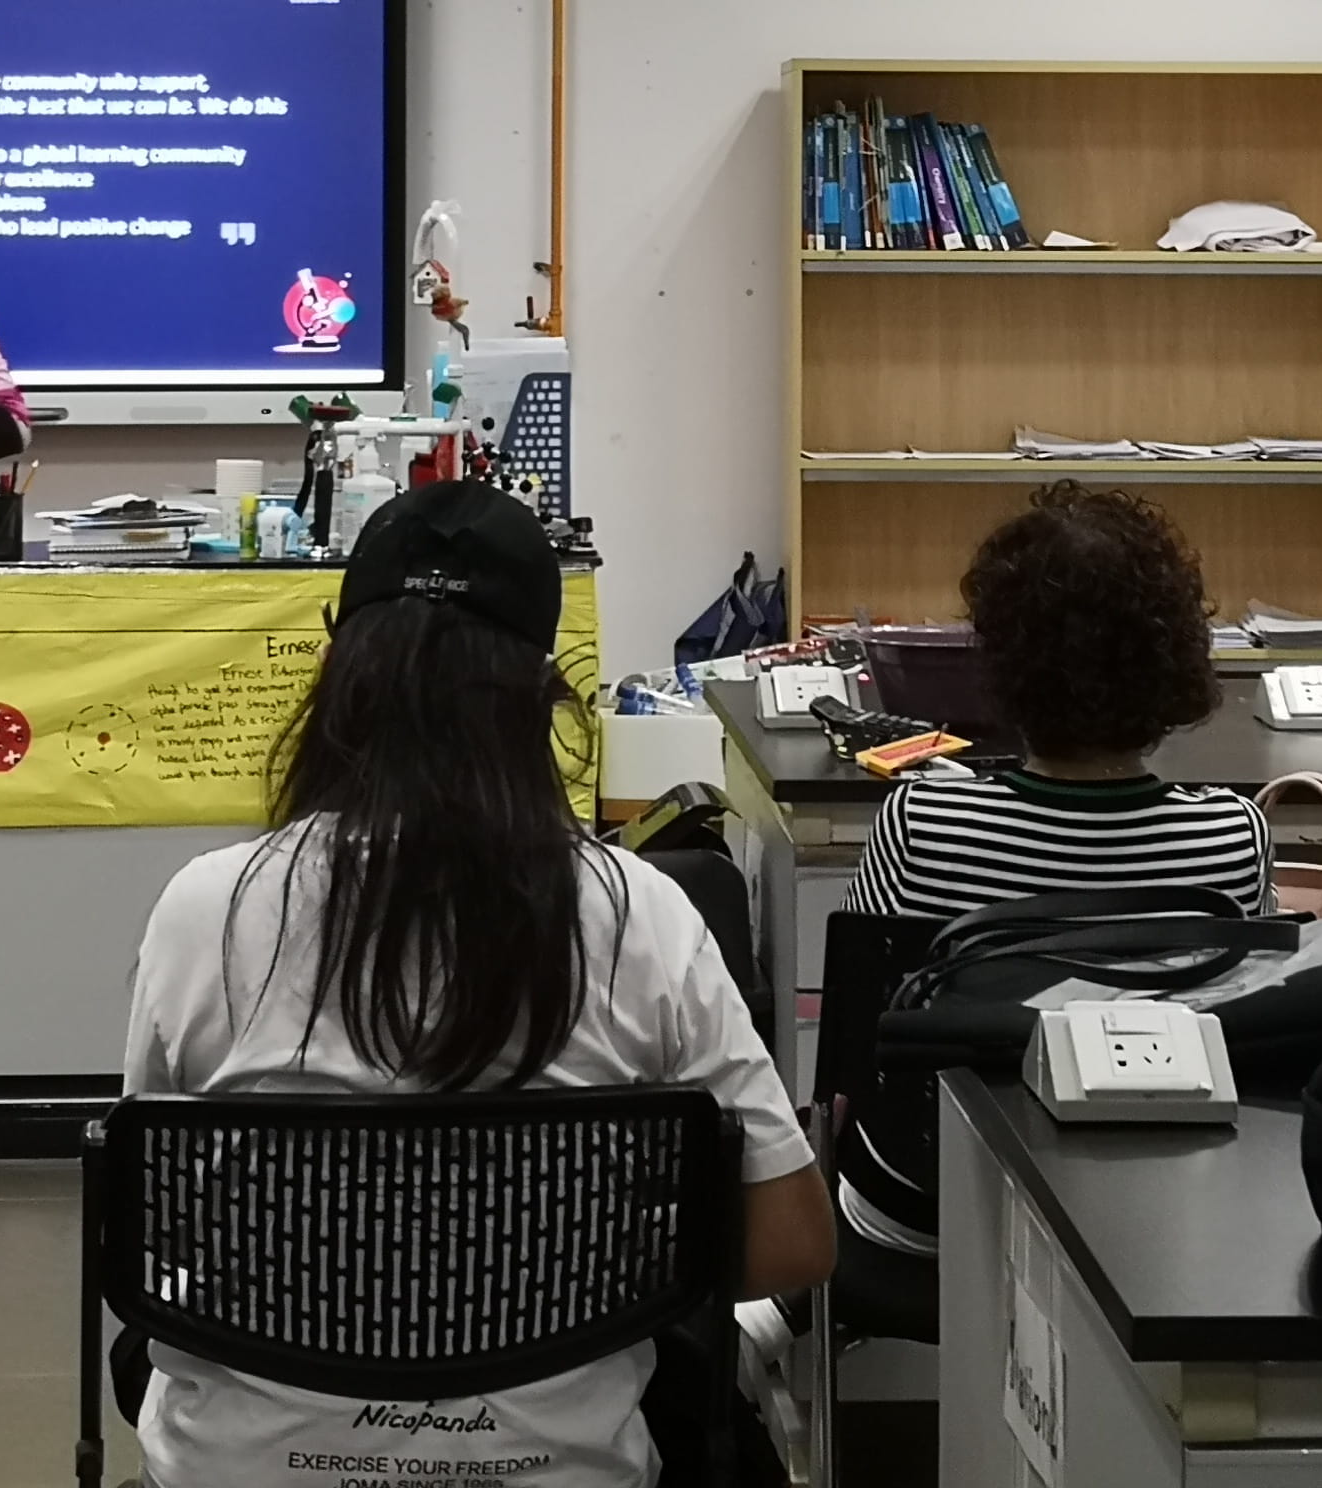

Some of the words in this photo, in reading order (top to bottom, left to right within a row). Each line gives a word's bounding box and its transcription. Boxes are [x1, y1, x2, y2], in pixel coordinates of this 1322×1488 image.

[2, 73, 98, 94] community
[99, 73, 138, 91] who
[138, 74, 209, 94] support,
[27, 96, 67, 115] best
[67, 96, 106, 115] that
[106, 100, 135, 115] we
[134, 100, 168, 115] can
[168, 96, 196, 115] be.
[198, 96, 229, 115] We
[229, 96, 254, 115] do
[254, 96, 289, 115] this
[9, 149, 23, 163] a
[23, 145, 77, 167] global
[77, 145, 149, 167] learning
[149, 146, 247, 167] community
[4, 169, 95, 188] excellence
[19, 217, 59, 236] lead
[59, 217, 129, 239] positive
[128, 217, 193, 239] change
[266, 635, 322, 659] Ernes
[222, 667, 264, 682] Ernest
[352, 1403, 498, 1435] Nicopanda
[288, 1451, 389, 1474] EXERCISE
[394, 1458, 451, 1476] YOUR
[455, 1454, 552, 1476] FREEDOM
[333, 1477, 389, 1488] JOMA
[396, 1479, 456, 1488] SINCE
